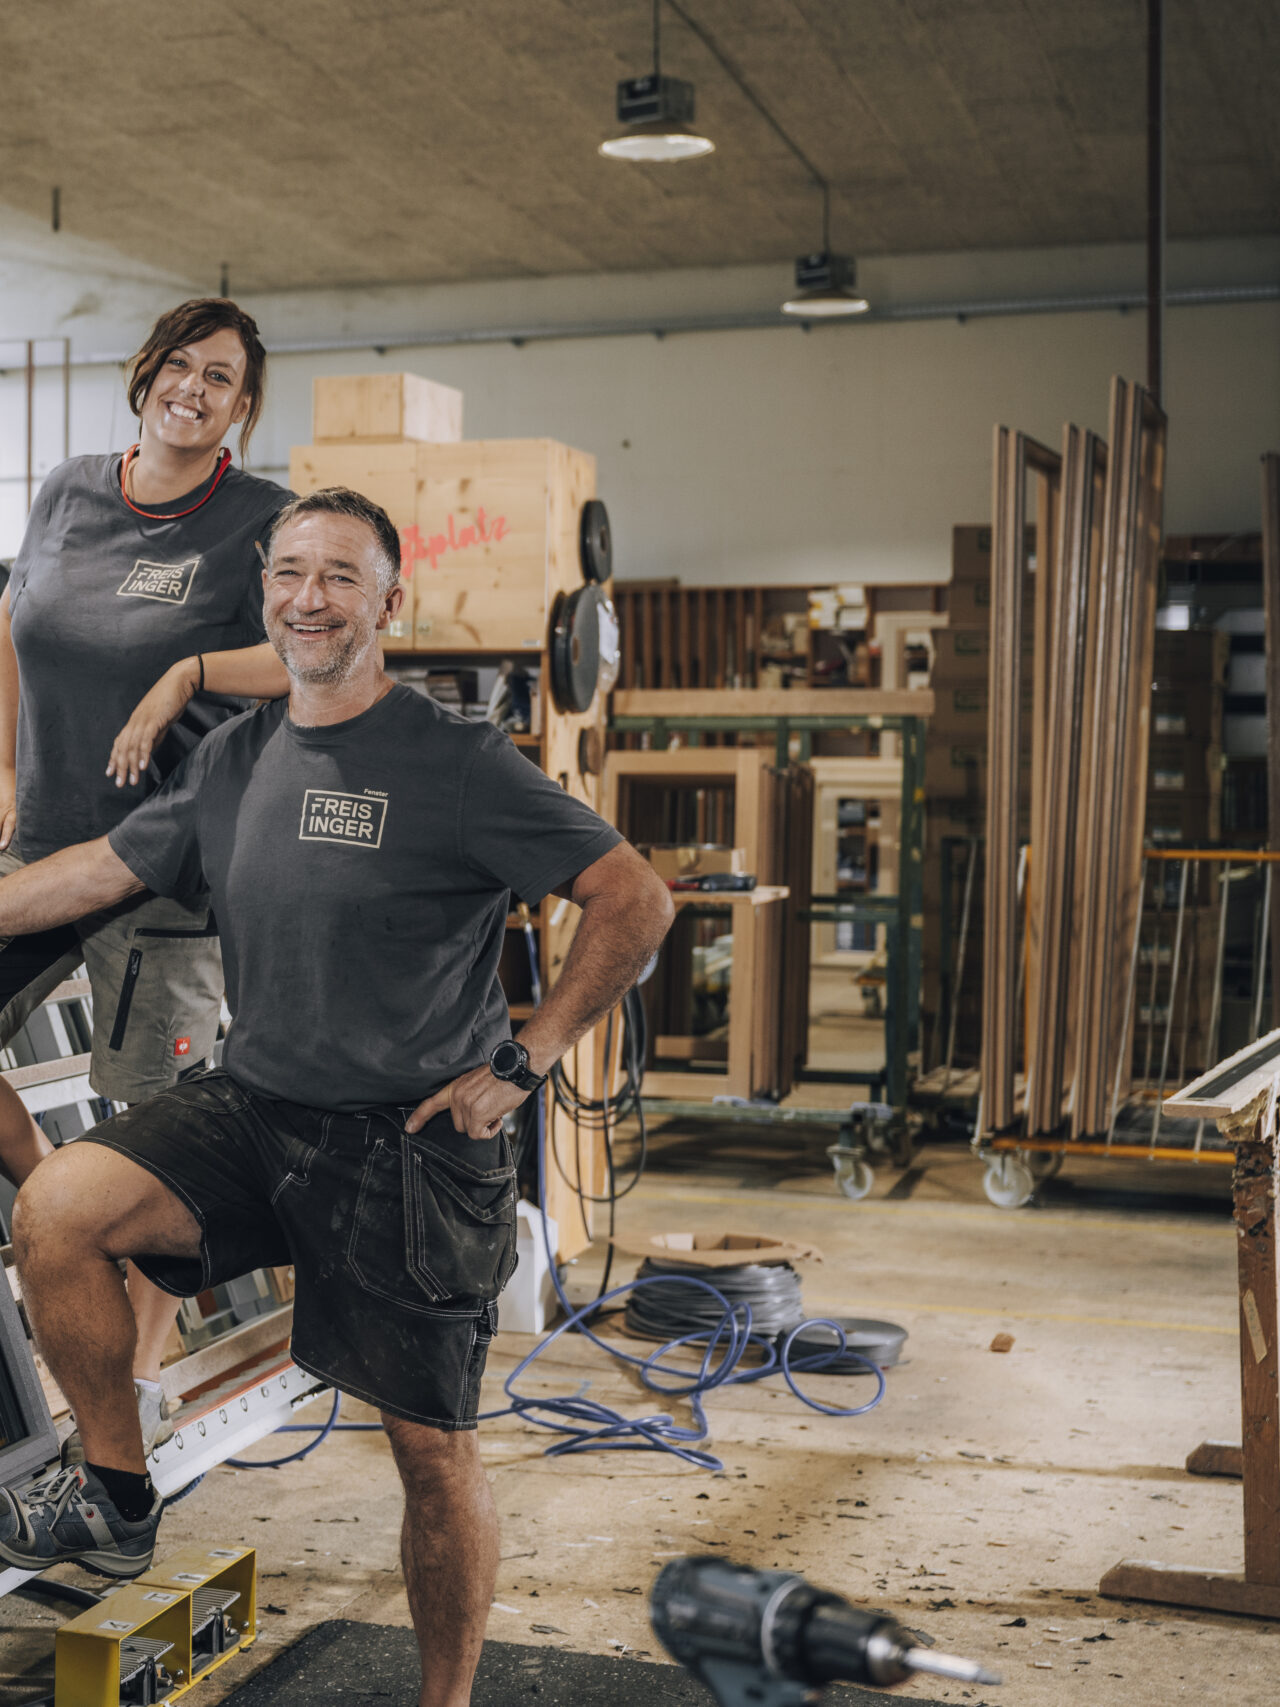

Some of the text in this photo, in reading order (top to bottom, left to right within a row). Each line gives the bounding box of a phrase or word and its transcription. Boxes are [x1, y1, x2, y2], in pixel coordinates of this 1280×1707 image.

[137, 567, 185, 580] FREIS
[128, 579, 183, 597] INGER
[363, 788, 389, 798] Fenster
[311, 797, 373, 820] FREIS
[308, 815, 374, 840] INGER
